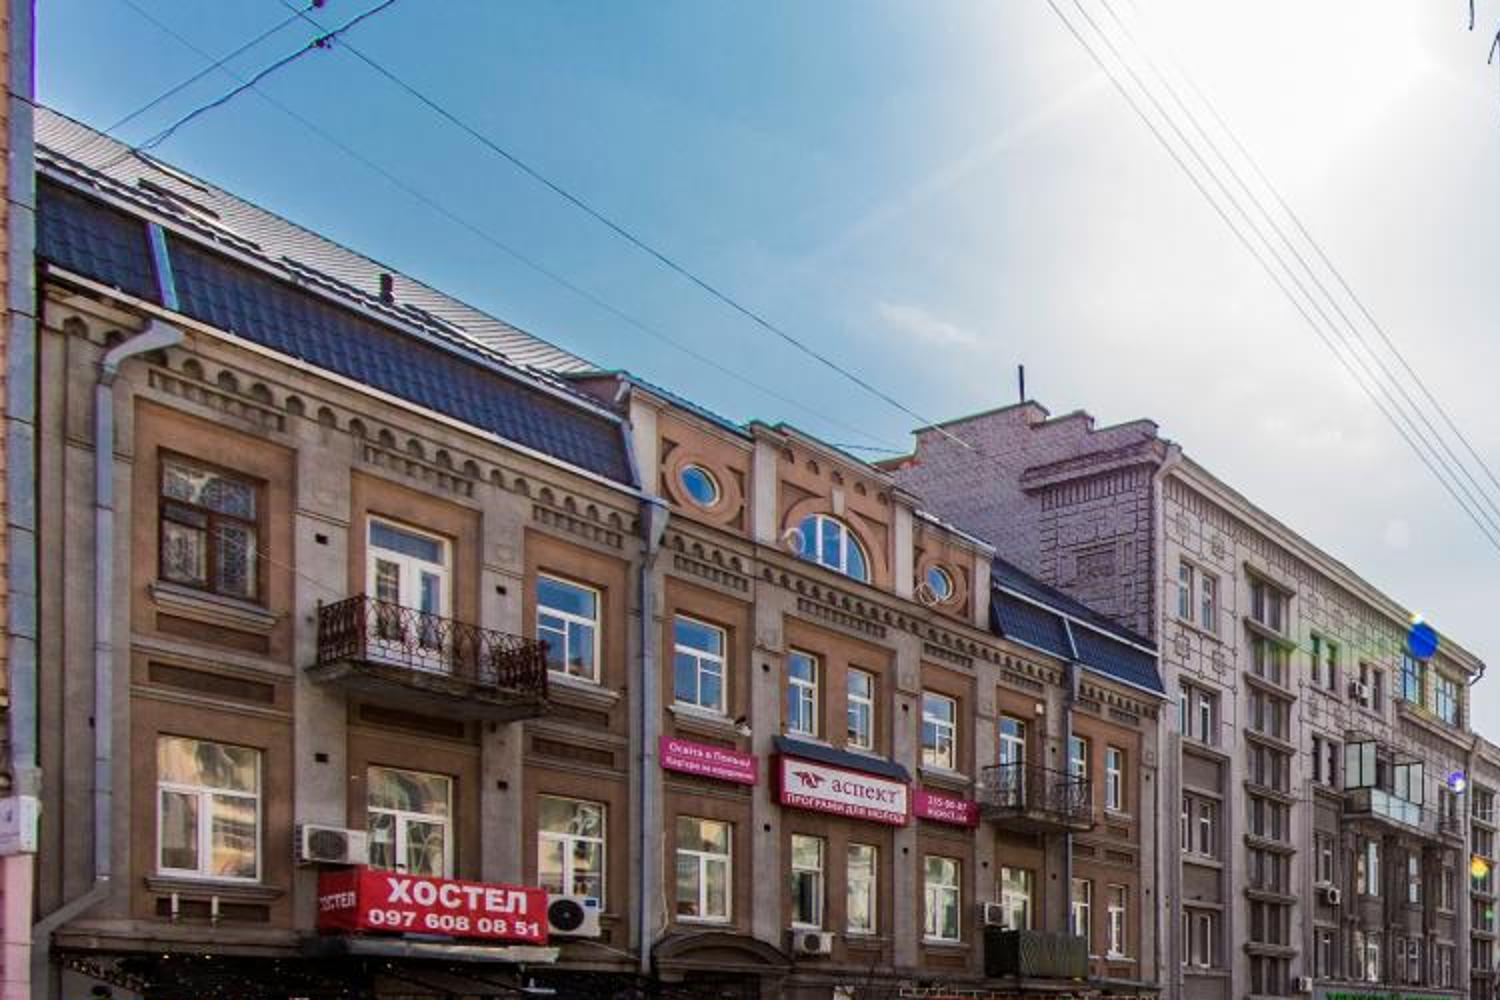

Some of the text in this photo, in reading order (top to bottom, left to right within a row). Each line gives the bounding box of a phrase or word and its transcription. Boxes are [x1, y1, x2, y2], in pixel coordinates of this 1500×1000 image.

[831, 779, 898, 804] аспект
[386, 877, 528, 915] ХОСТЕЛ
[368, 908, 540, 937] 097 608 08 51
